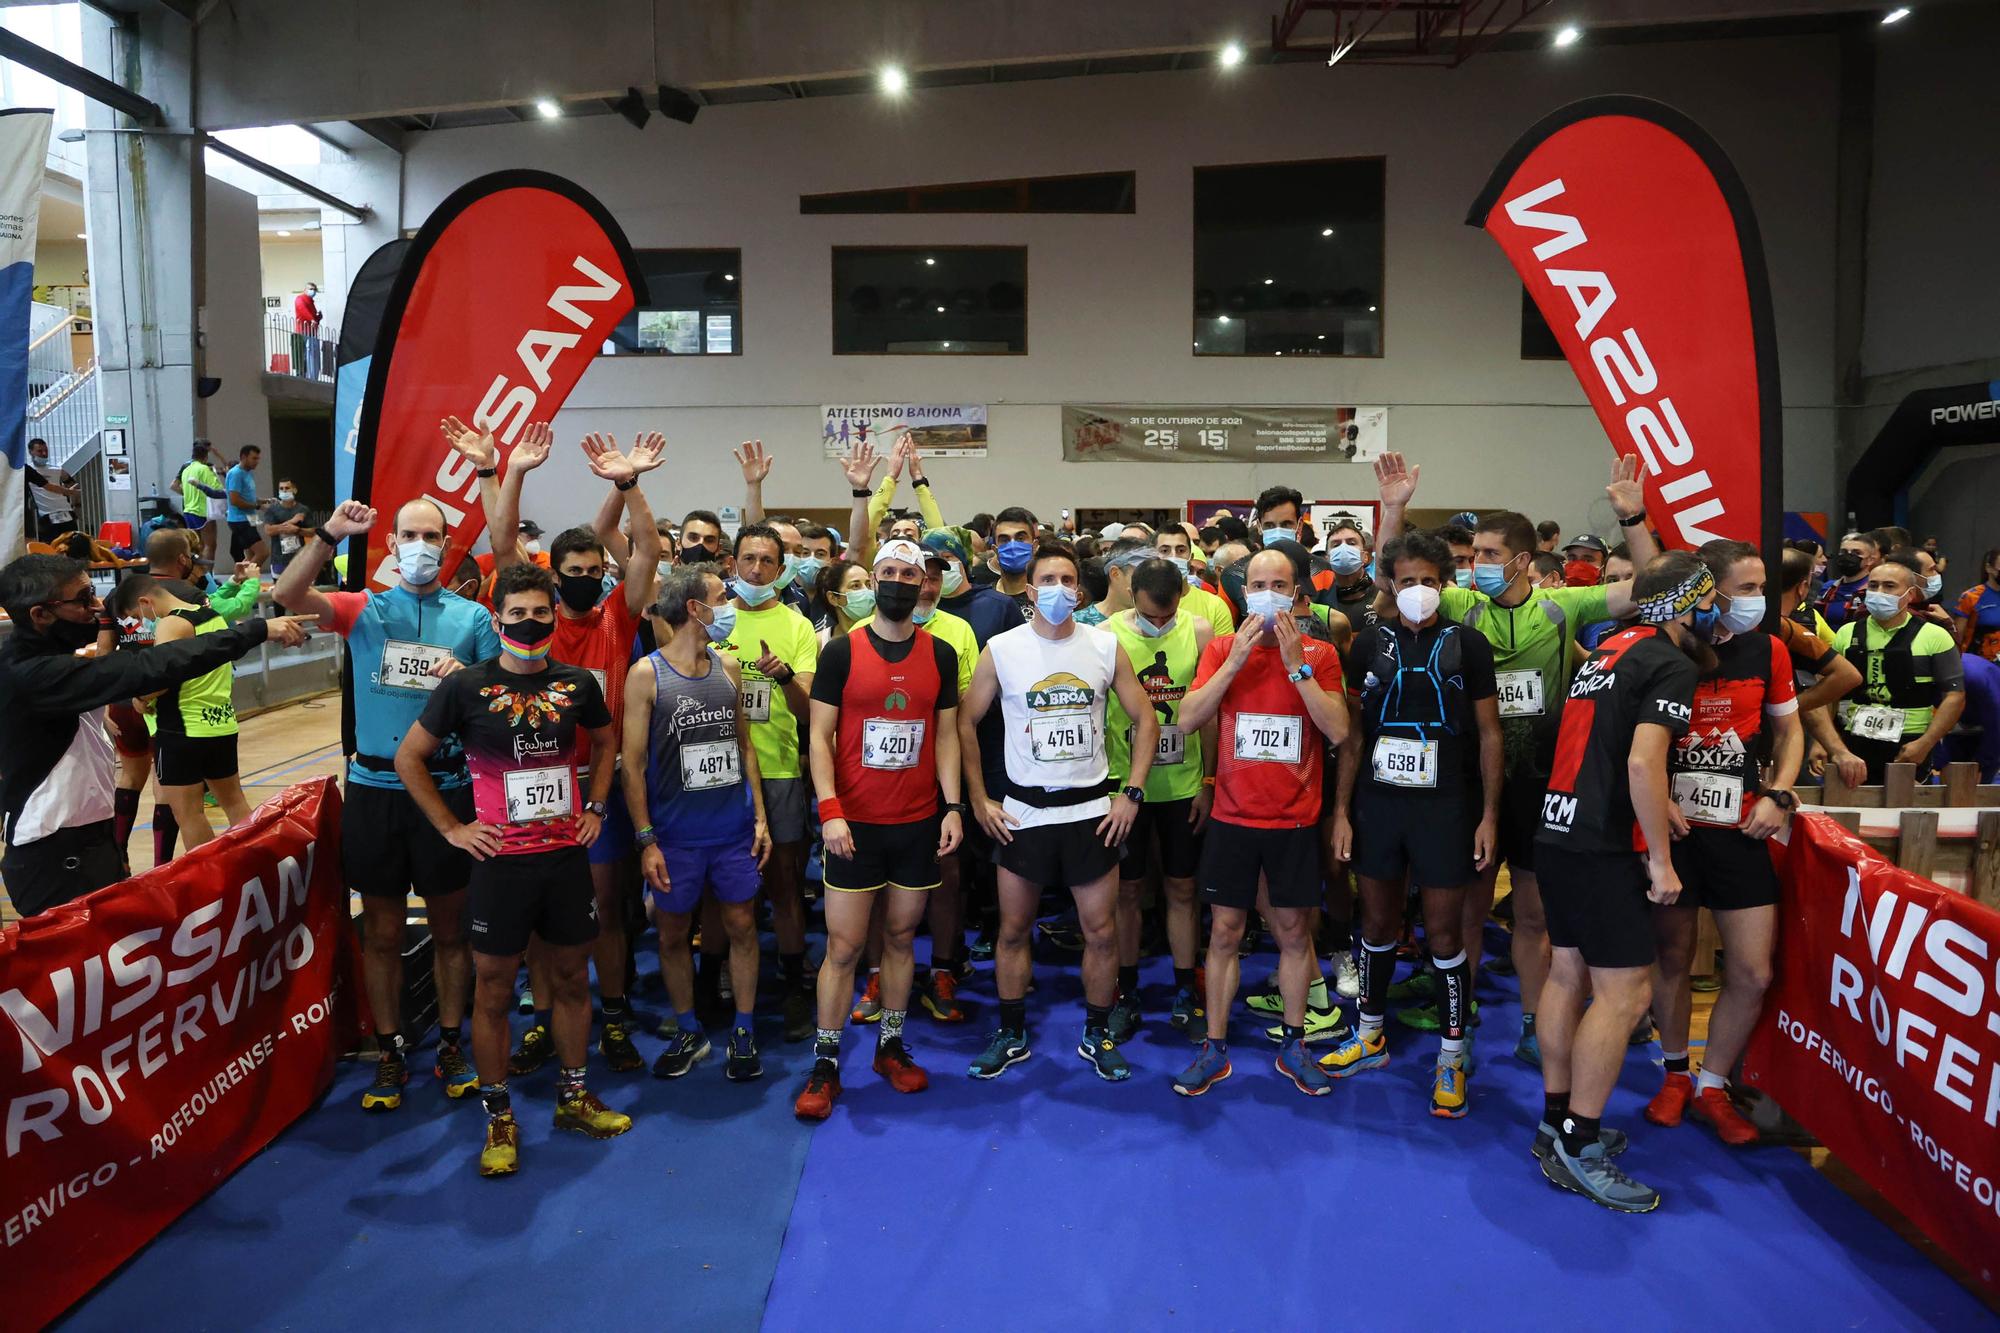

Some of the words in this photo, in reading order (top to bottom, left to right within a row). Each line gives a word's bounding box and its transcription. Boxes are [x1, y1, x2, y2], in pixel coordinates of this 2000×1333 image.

[827, 407, 903, 418] ATLETISMO
[907, 407, 962, 418] BAIONA
[1130, 417, 1139, 425] 31
[1142, 417, 1154, 425] DE
[1157, 417, 1204, 425] OUTUBRO
[1206, 417, 1219, 425] DE
[1221, 417, 1243, 425] 2021
[1144, 430, 1174, 446] 25
[1197, 430, 1224, 446] 15
[400, 657, 430, 677] 539
[1033, 692, 1046, 706] A
[1498, 686, 1524, 703] 464
[1656, 699, 1693, 720] TCM
[1700, 706, 1731, 714] REYCO
[1865, 716, 1885, 731] 614
[880, 737, 907, 754] 420
[1048, 730, 1075, 747] 476
[1253, 730, 1280, 747] 702
[699, 756, 723, 775] 487
[1388, 753, 1415, 772] 638
[526, 784, 555, 806] 572
[1690, 787, 1721, 808] 450
[0, 842, 315, 1073] NISSAN
[6, 921, 315, 1158] ROFERVIGO
[1778, 1010, 1893, 1115] ROFERVIGO
[150, 1037, 275, 1160] ROFEOURENSE
